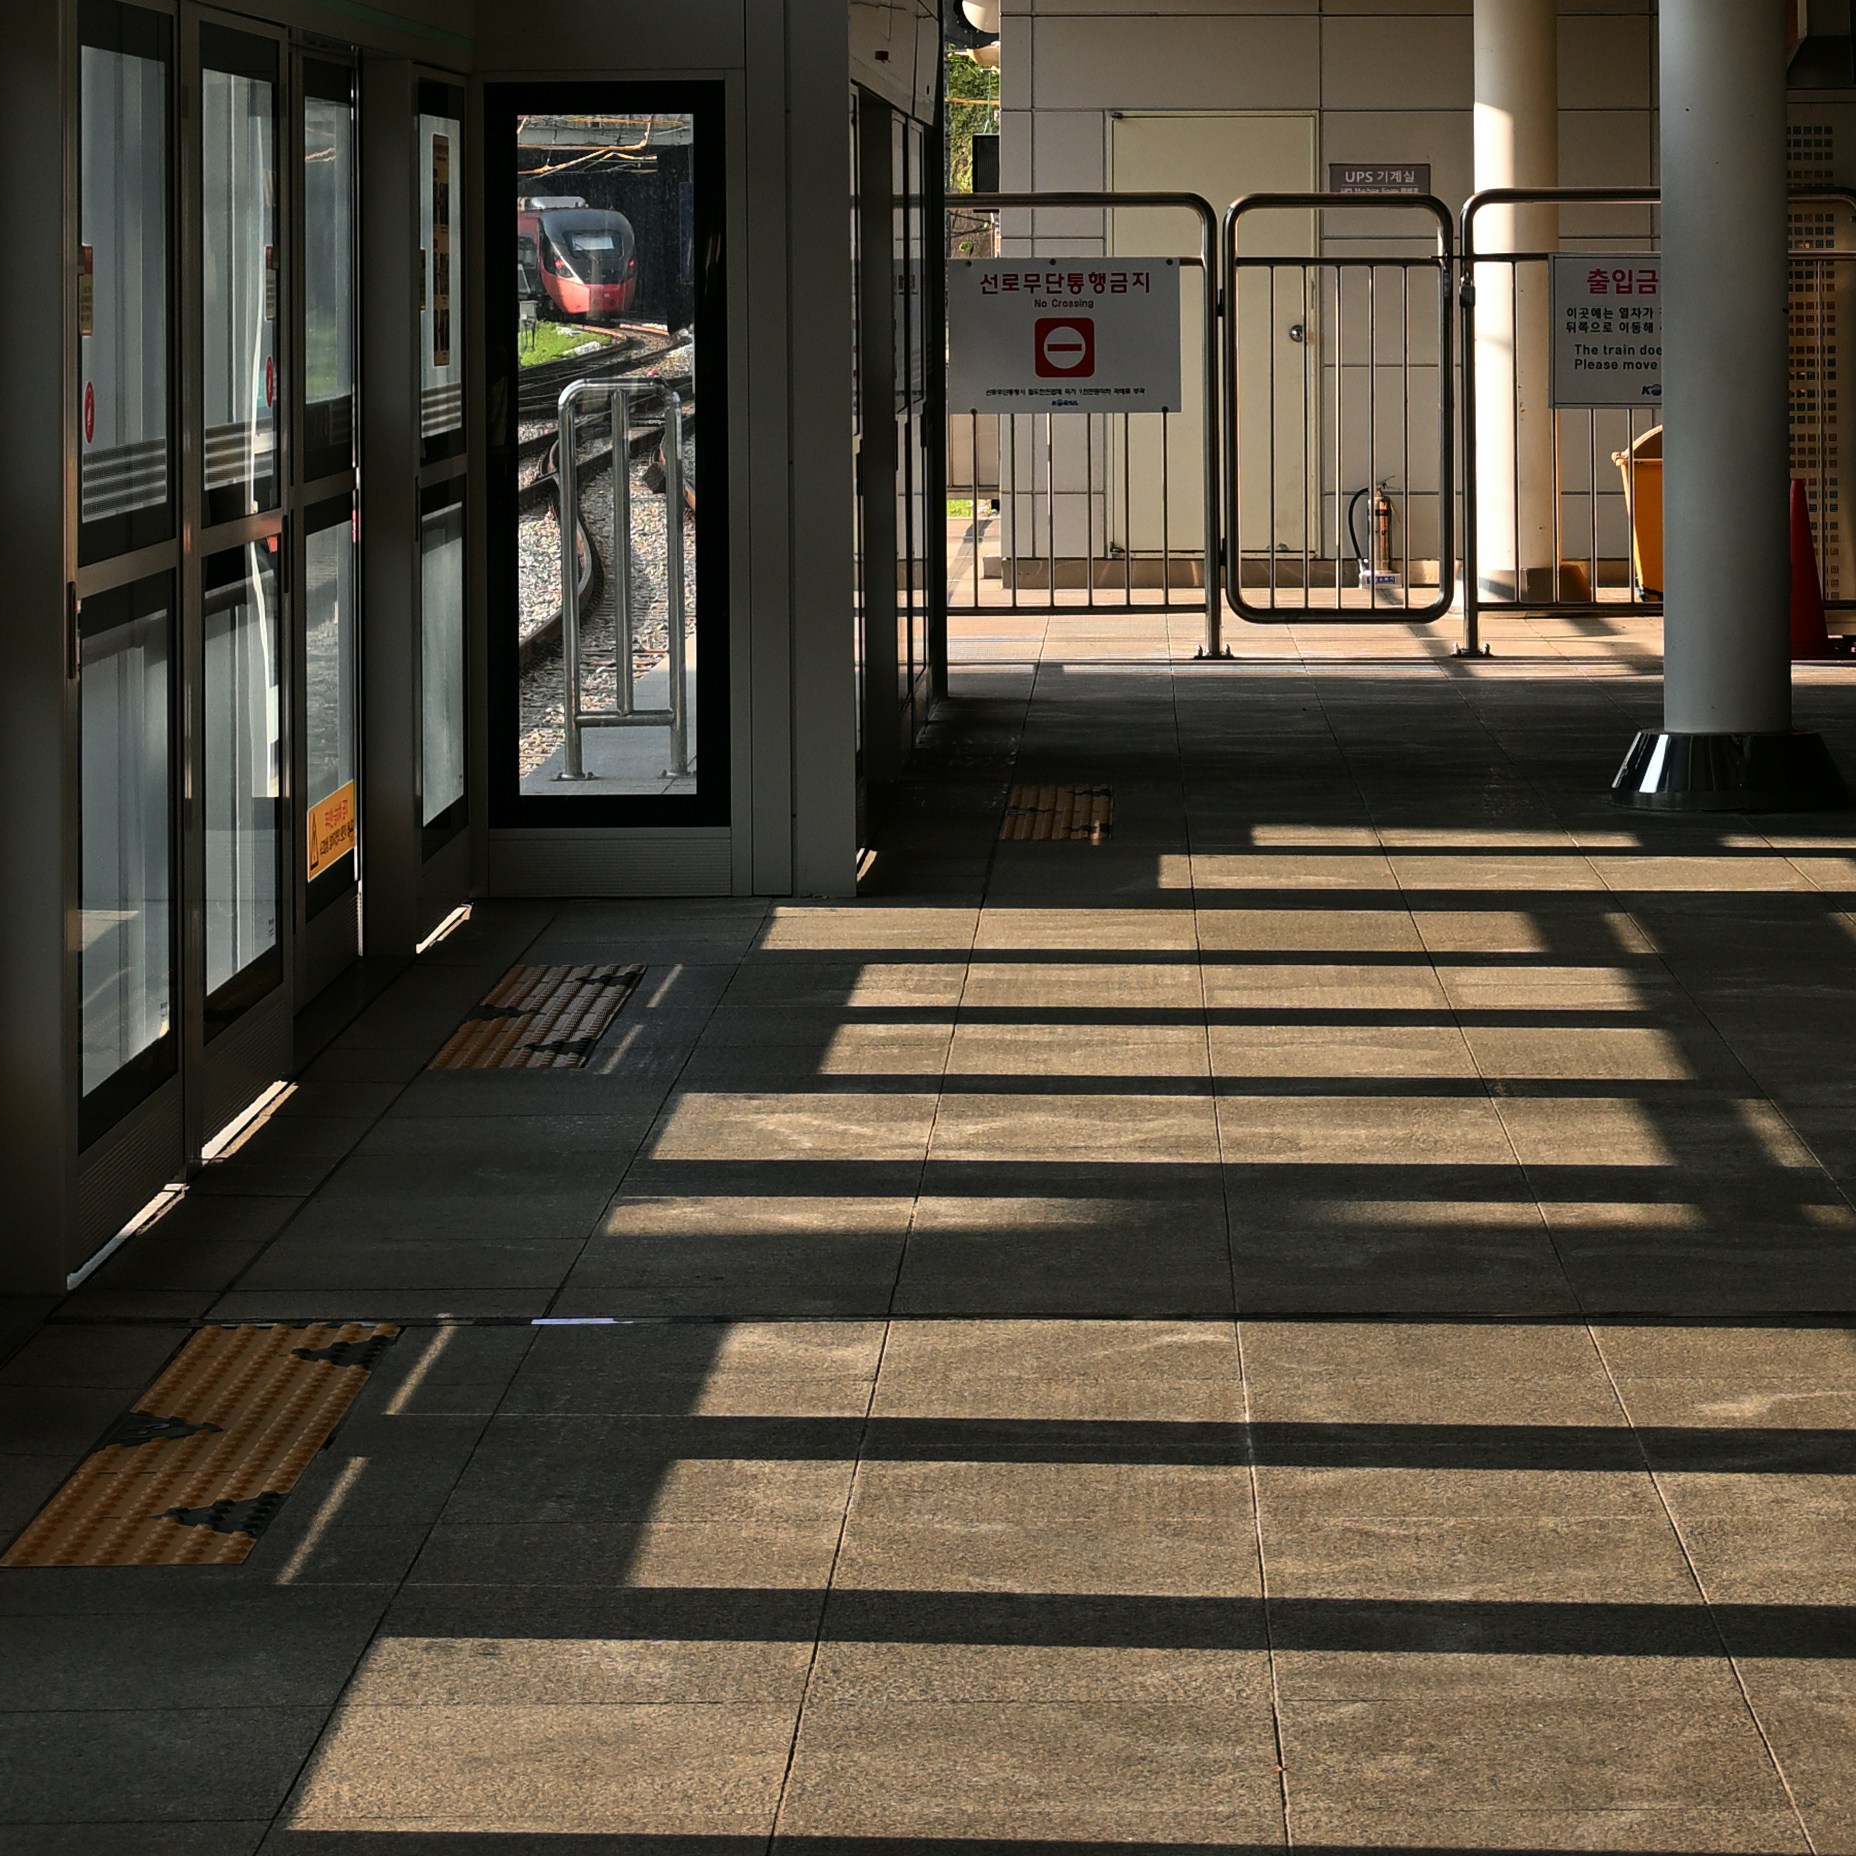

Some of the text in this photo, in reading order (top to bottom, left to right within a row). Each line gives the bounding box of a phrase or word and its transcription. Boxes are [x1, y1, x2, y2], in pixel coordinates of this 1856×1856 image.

[1345, 170, 1415, 183] UPS 기계실
[979, 271, 1150, 296] 선로무단통행금지
[1034, 298, 1094, 310] No Crossing
[1566, 307, 1654, 320] 이곳에는 열차가
[1565, 321, 1654, 334] 뒤쪽으로 이동해
[1574, 344, 1599, 355] The
[1603, 344, 1636, 355] train
[1574, 358, 1658, 371] Please move
